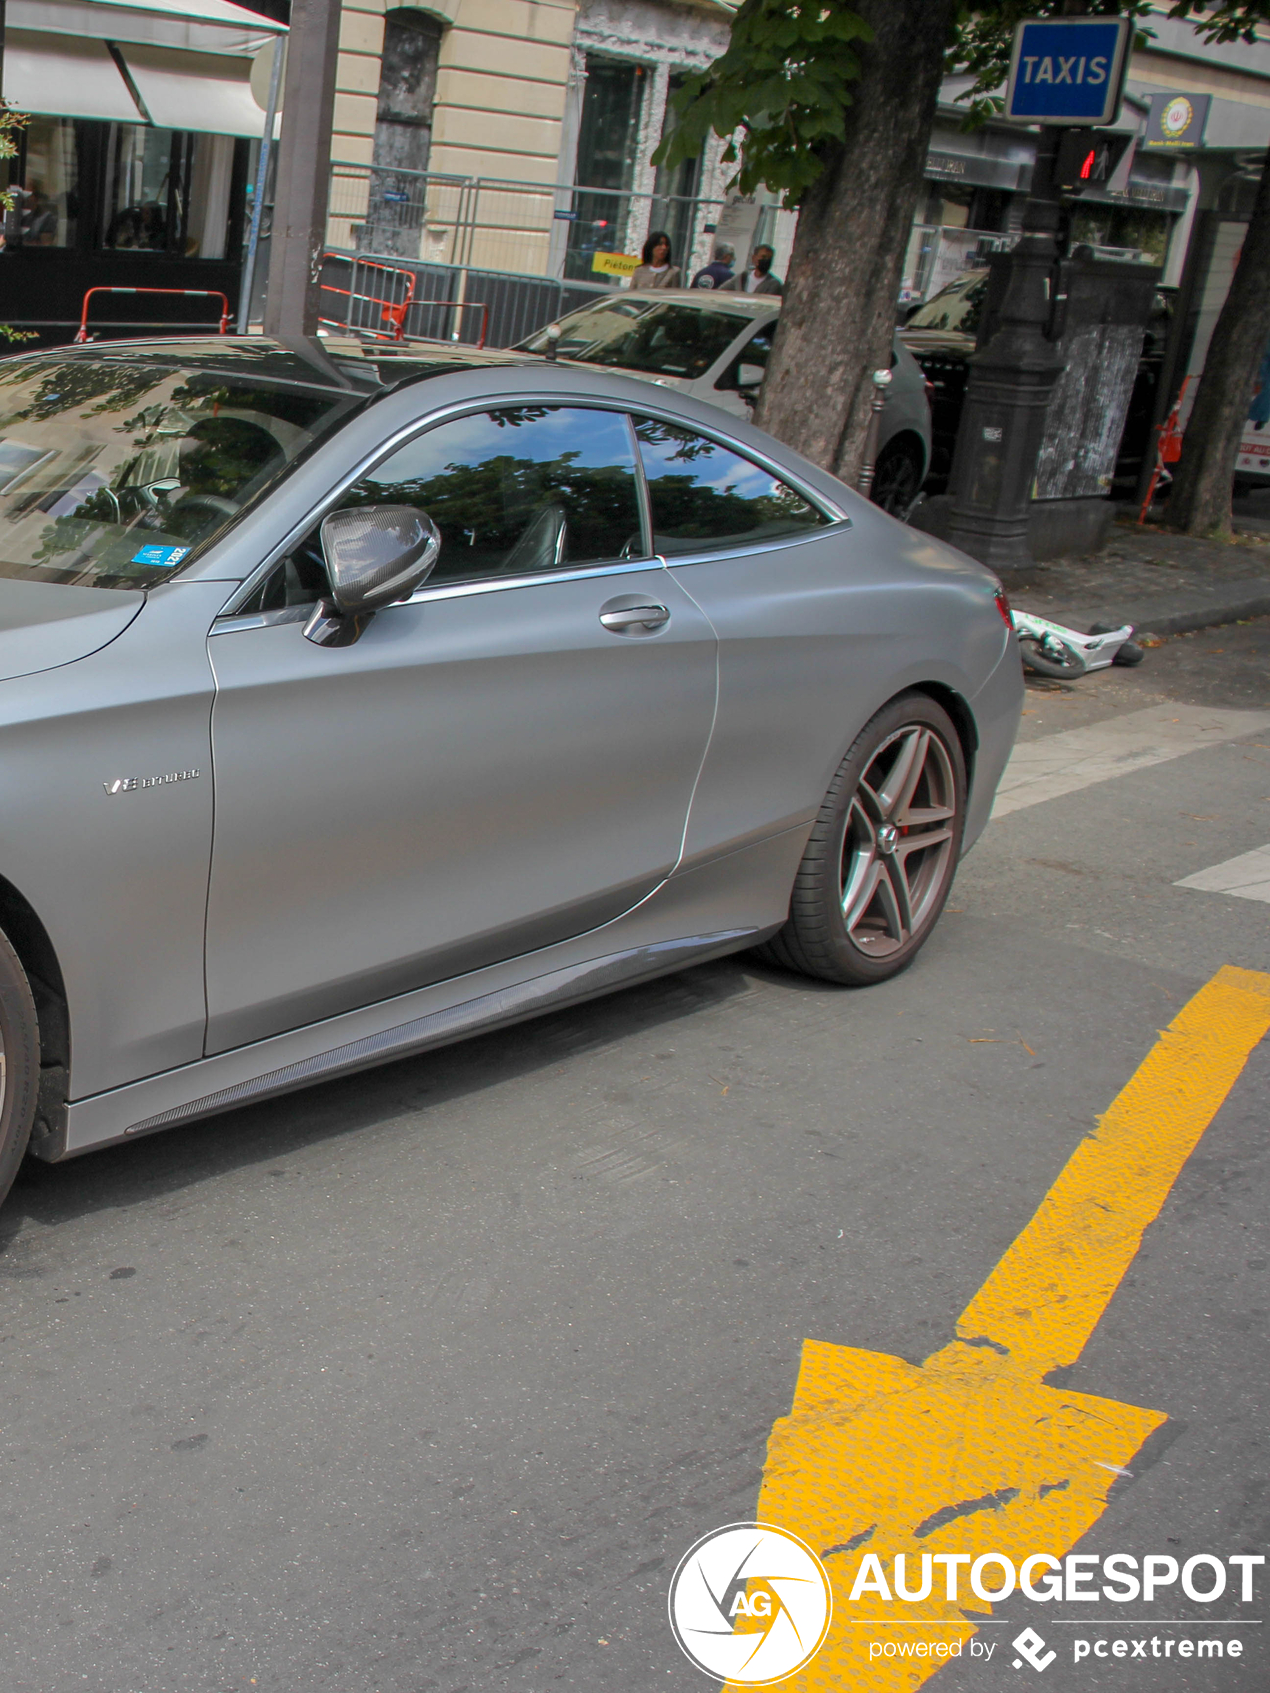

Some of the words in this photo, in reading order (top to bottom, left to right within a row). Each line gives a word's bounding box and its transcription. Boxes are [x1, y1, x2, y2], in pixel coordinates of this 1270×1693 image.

[1023, 56, 1108, 85] TAXIS
[164, 547, 187, 566] 2021
[103, 776, 139, 796] V8
